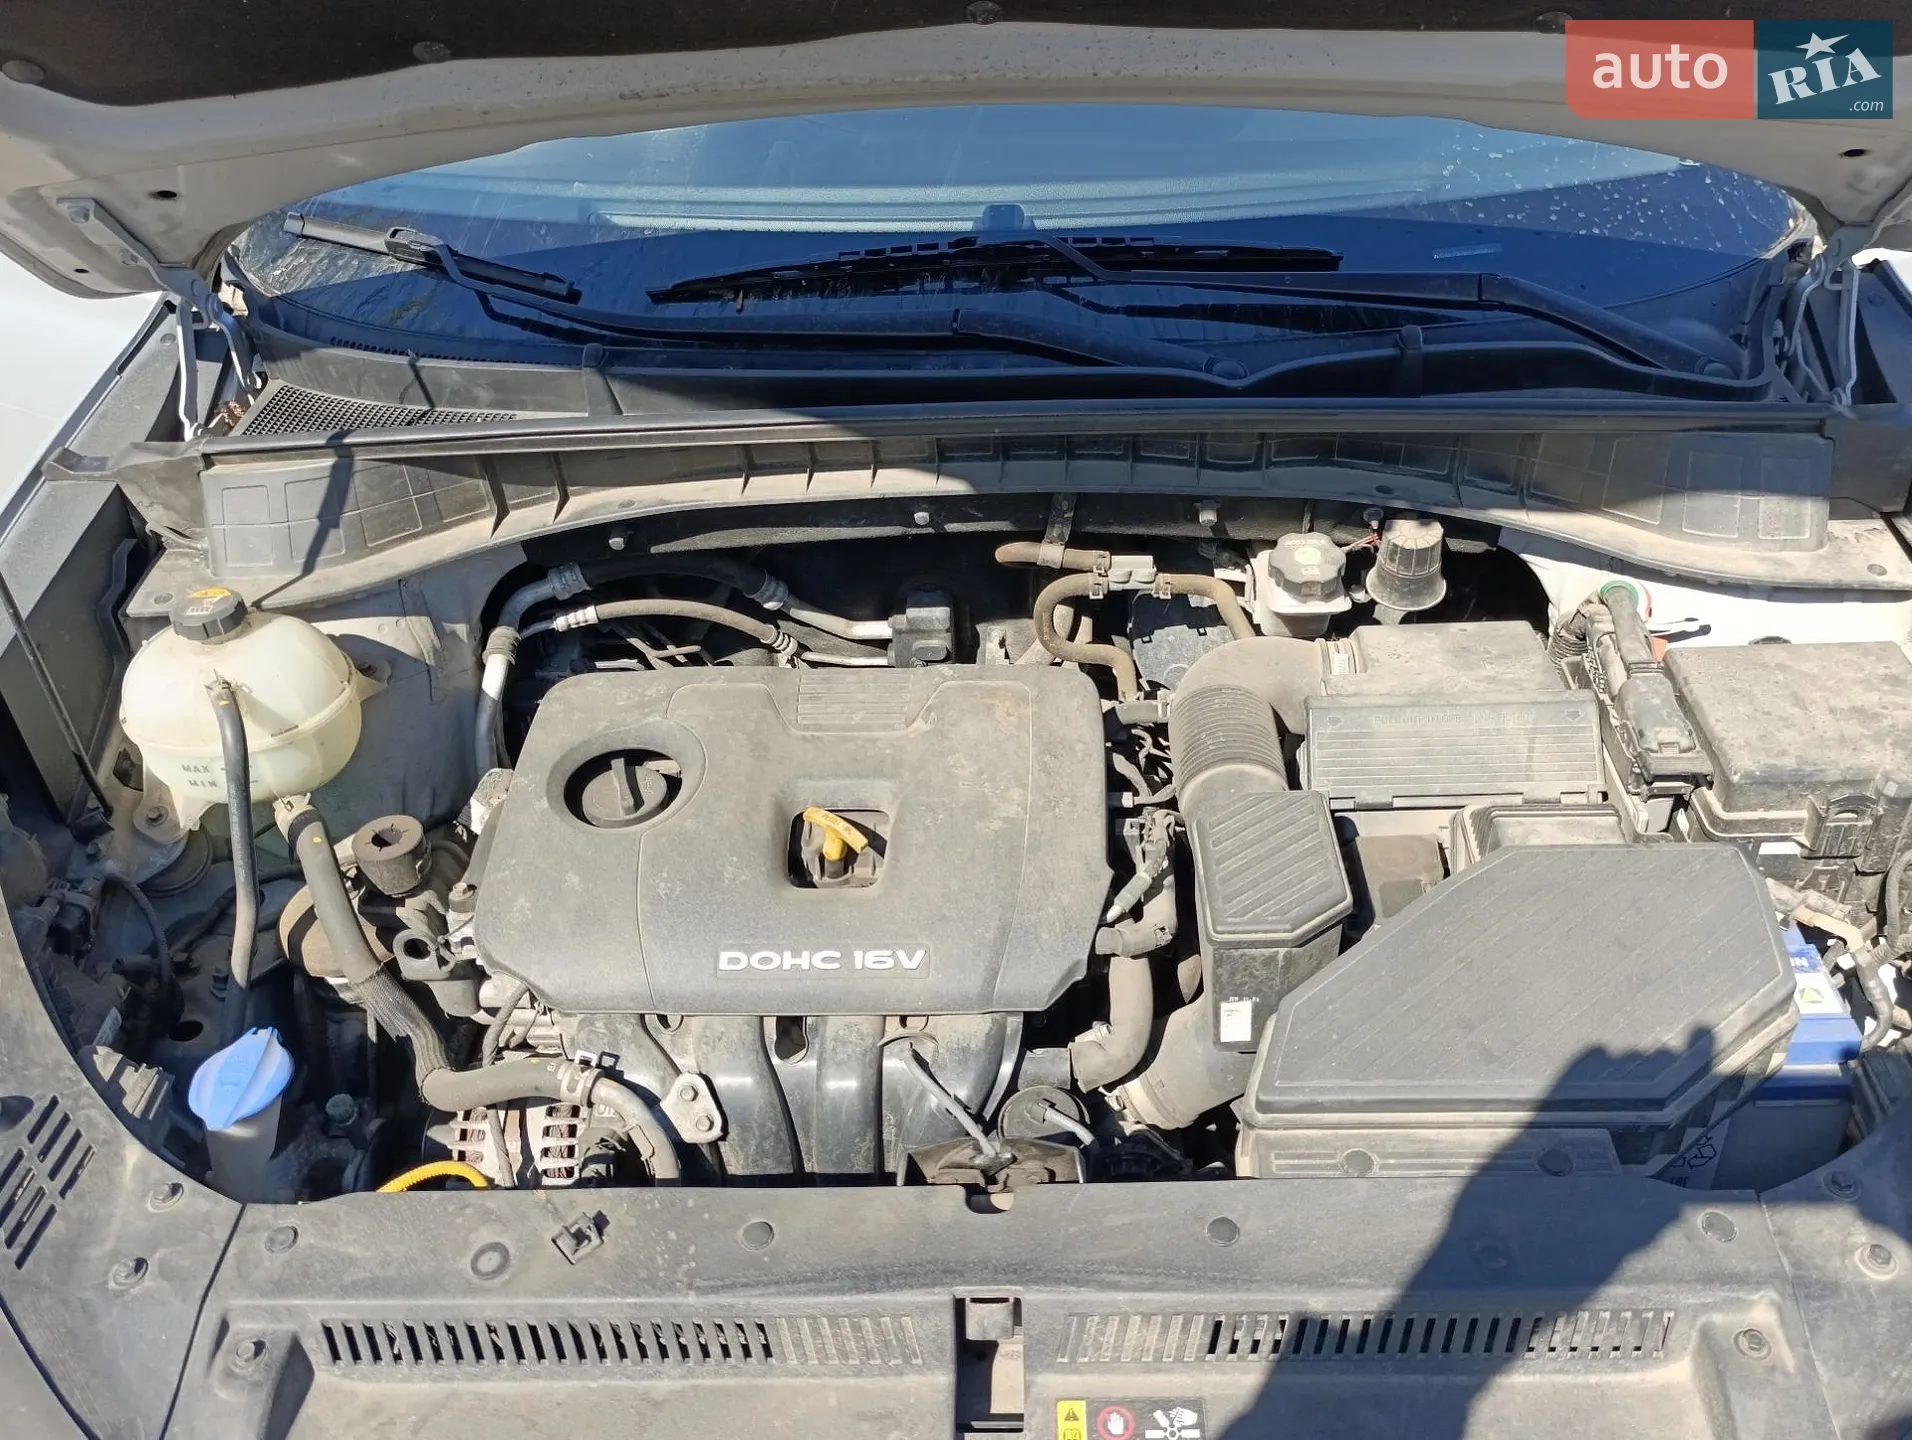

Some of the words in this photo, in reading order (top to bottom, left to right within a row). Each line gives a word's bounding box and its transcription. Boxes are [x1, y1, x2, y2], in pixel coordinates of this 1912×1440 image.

[182, 764, 210, 773] MAX
[188, 779, 217, 788] MIN
[719, 950, 842, 971] DOHC
[854, 949, 926, 970] 16V
